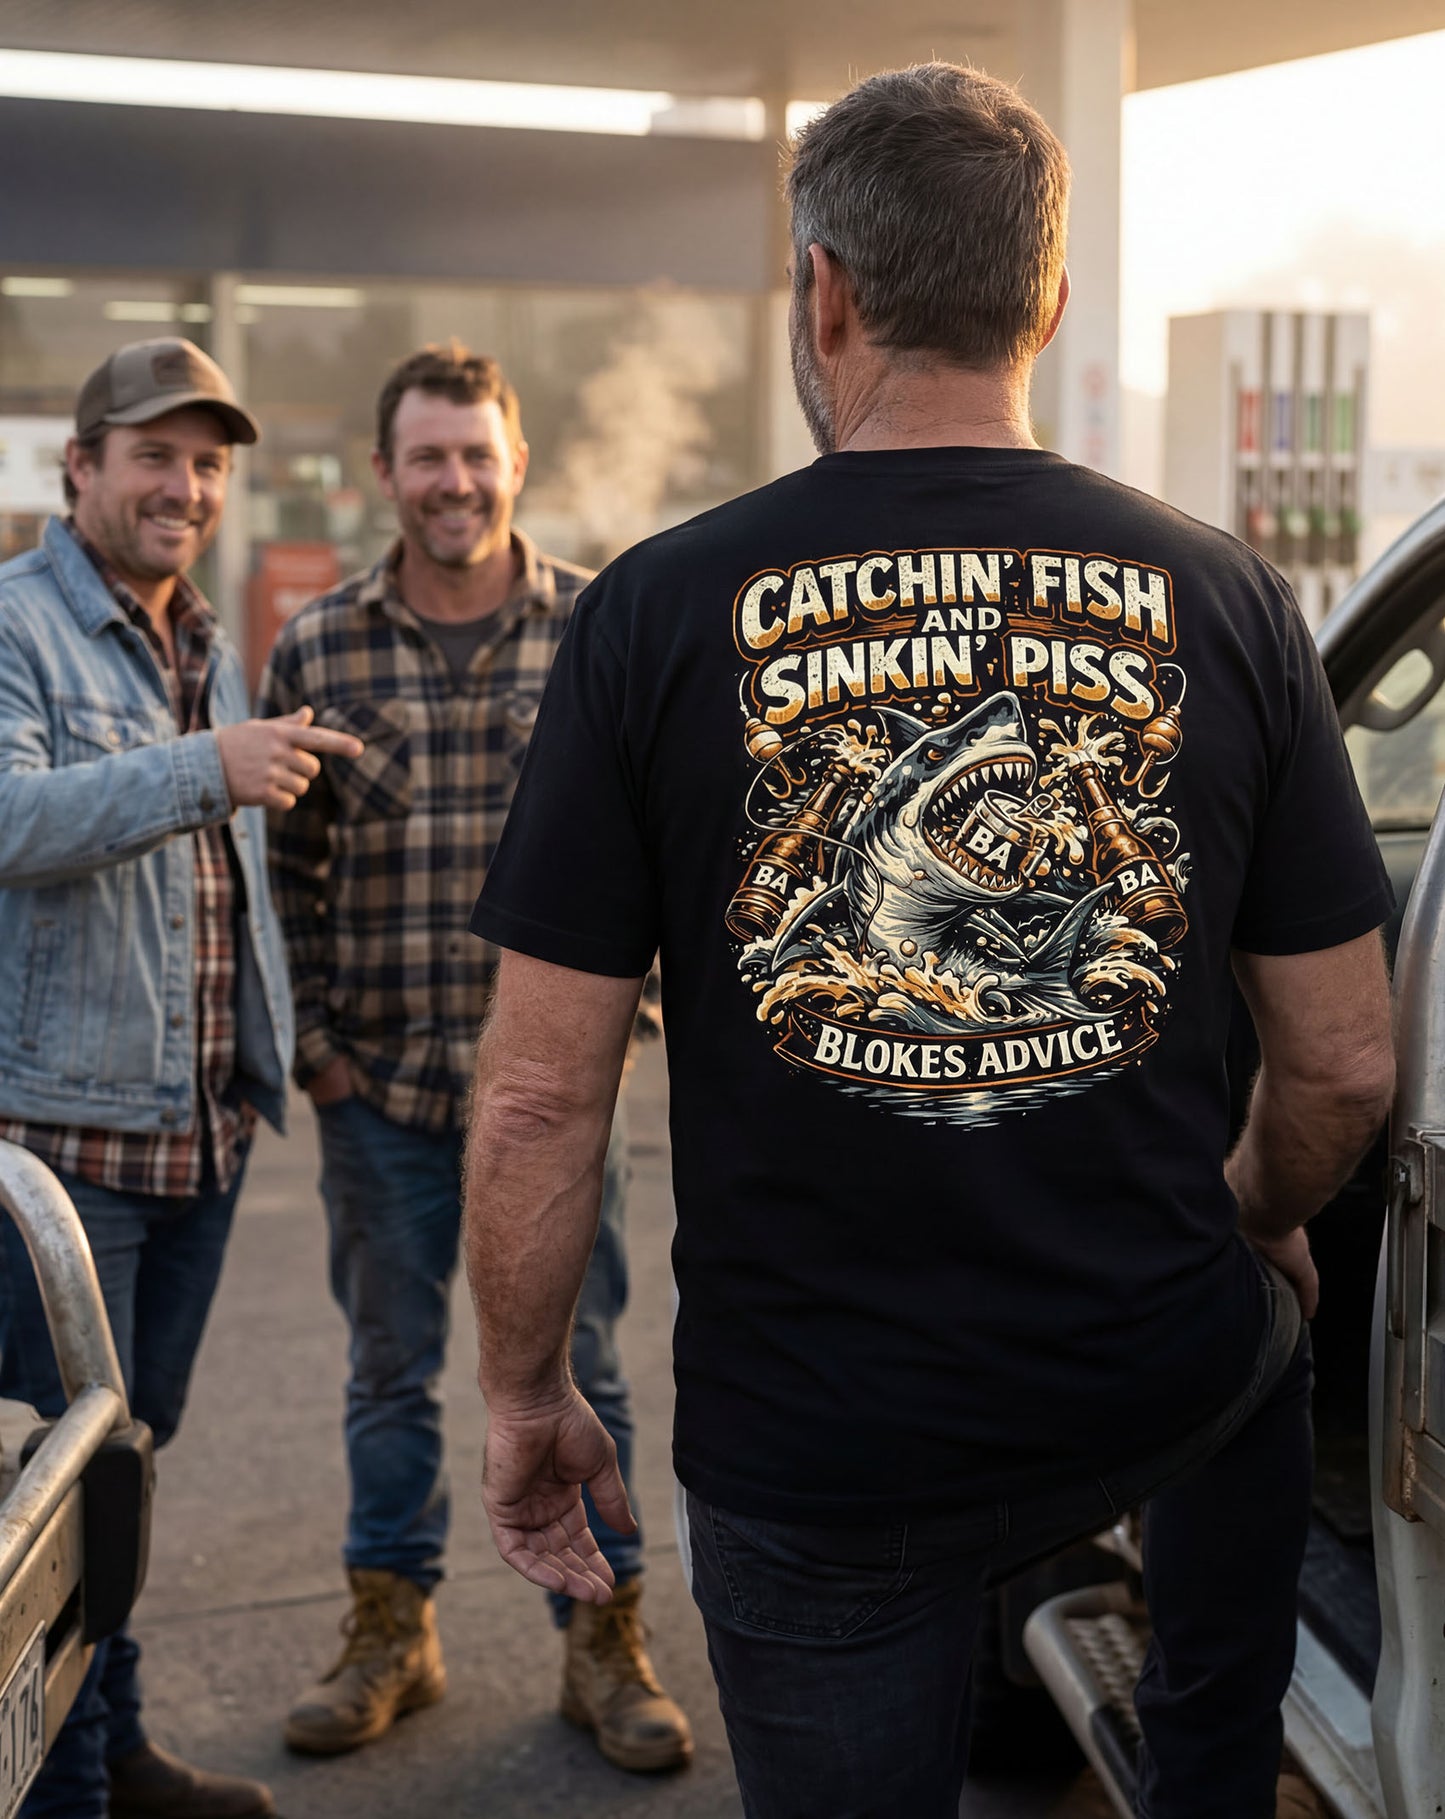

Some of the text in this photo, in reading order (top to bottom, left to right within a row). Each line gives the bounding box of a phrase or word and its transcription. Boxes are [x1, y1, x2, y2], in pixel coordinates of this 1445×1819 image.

[742, 553, 1169, 650] CATCHIN' FISH
[921, 608, 1001, 632] AND
[762, 635, 1154, 723] SINKIN' PISS
[970, 828, 1012, 871] BA
[752, 863, 789, 895] BA
[1116, 863, 1160, 895] BA
[813, 1019, 1122, 1079] BLOKES ADVICE
